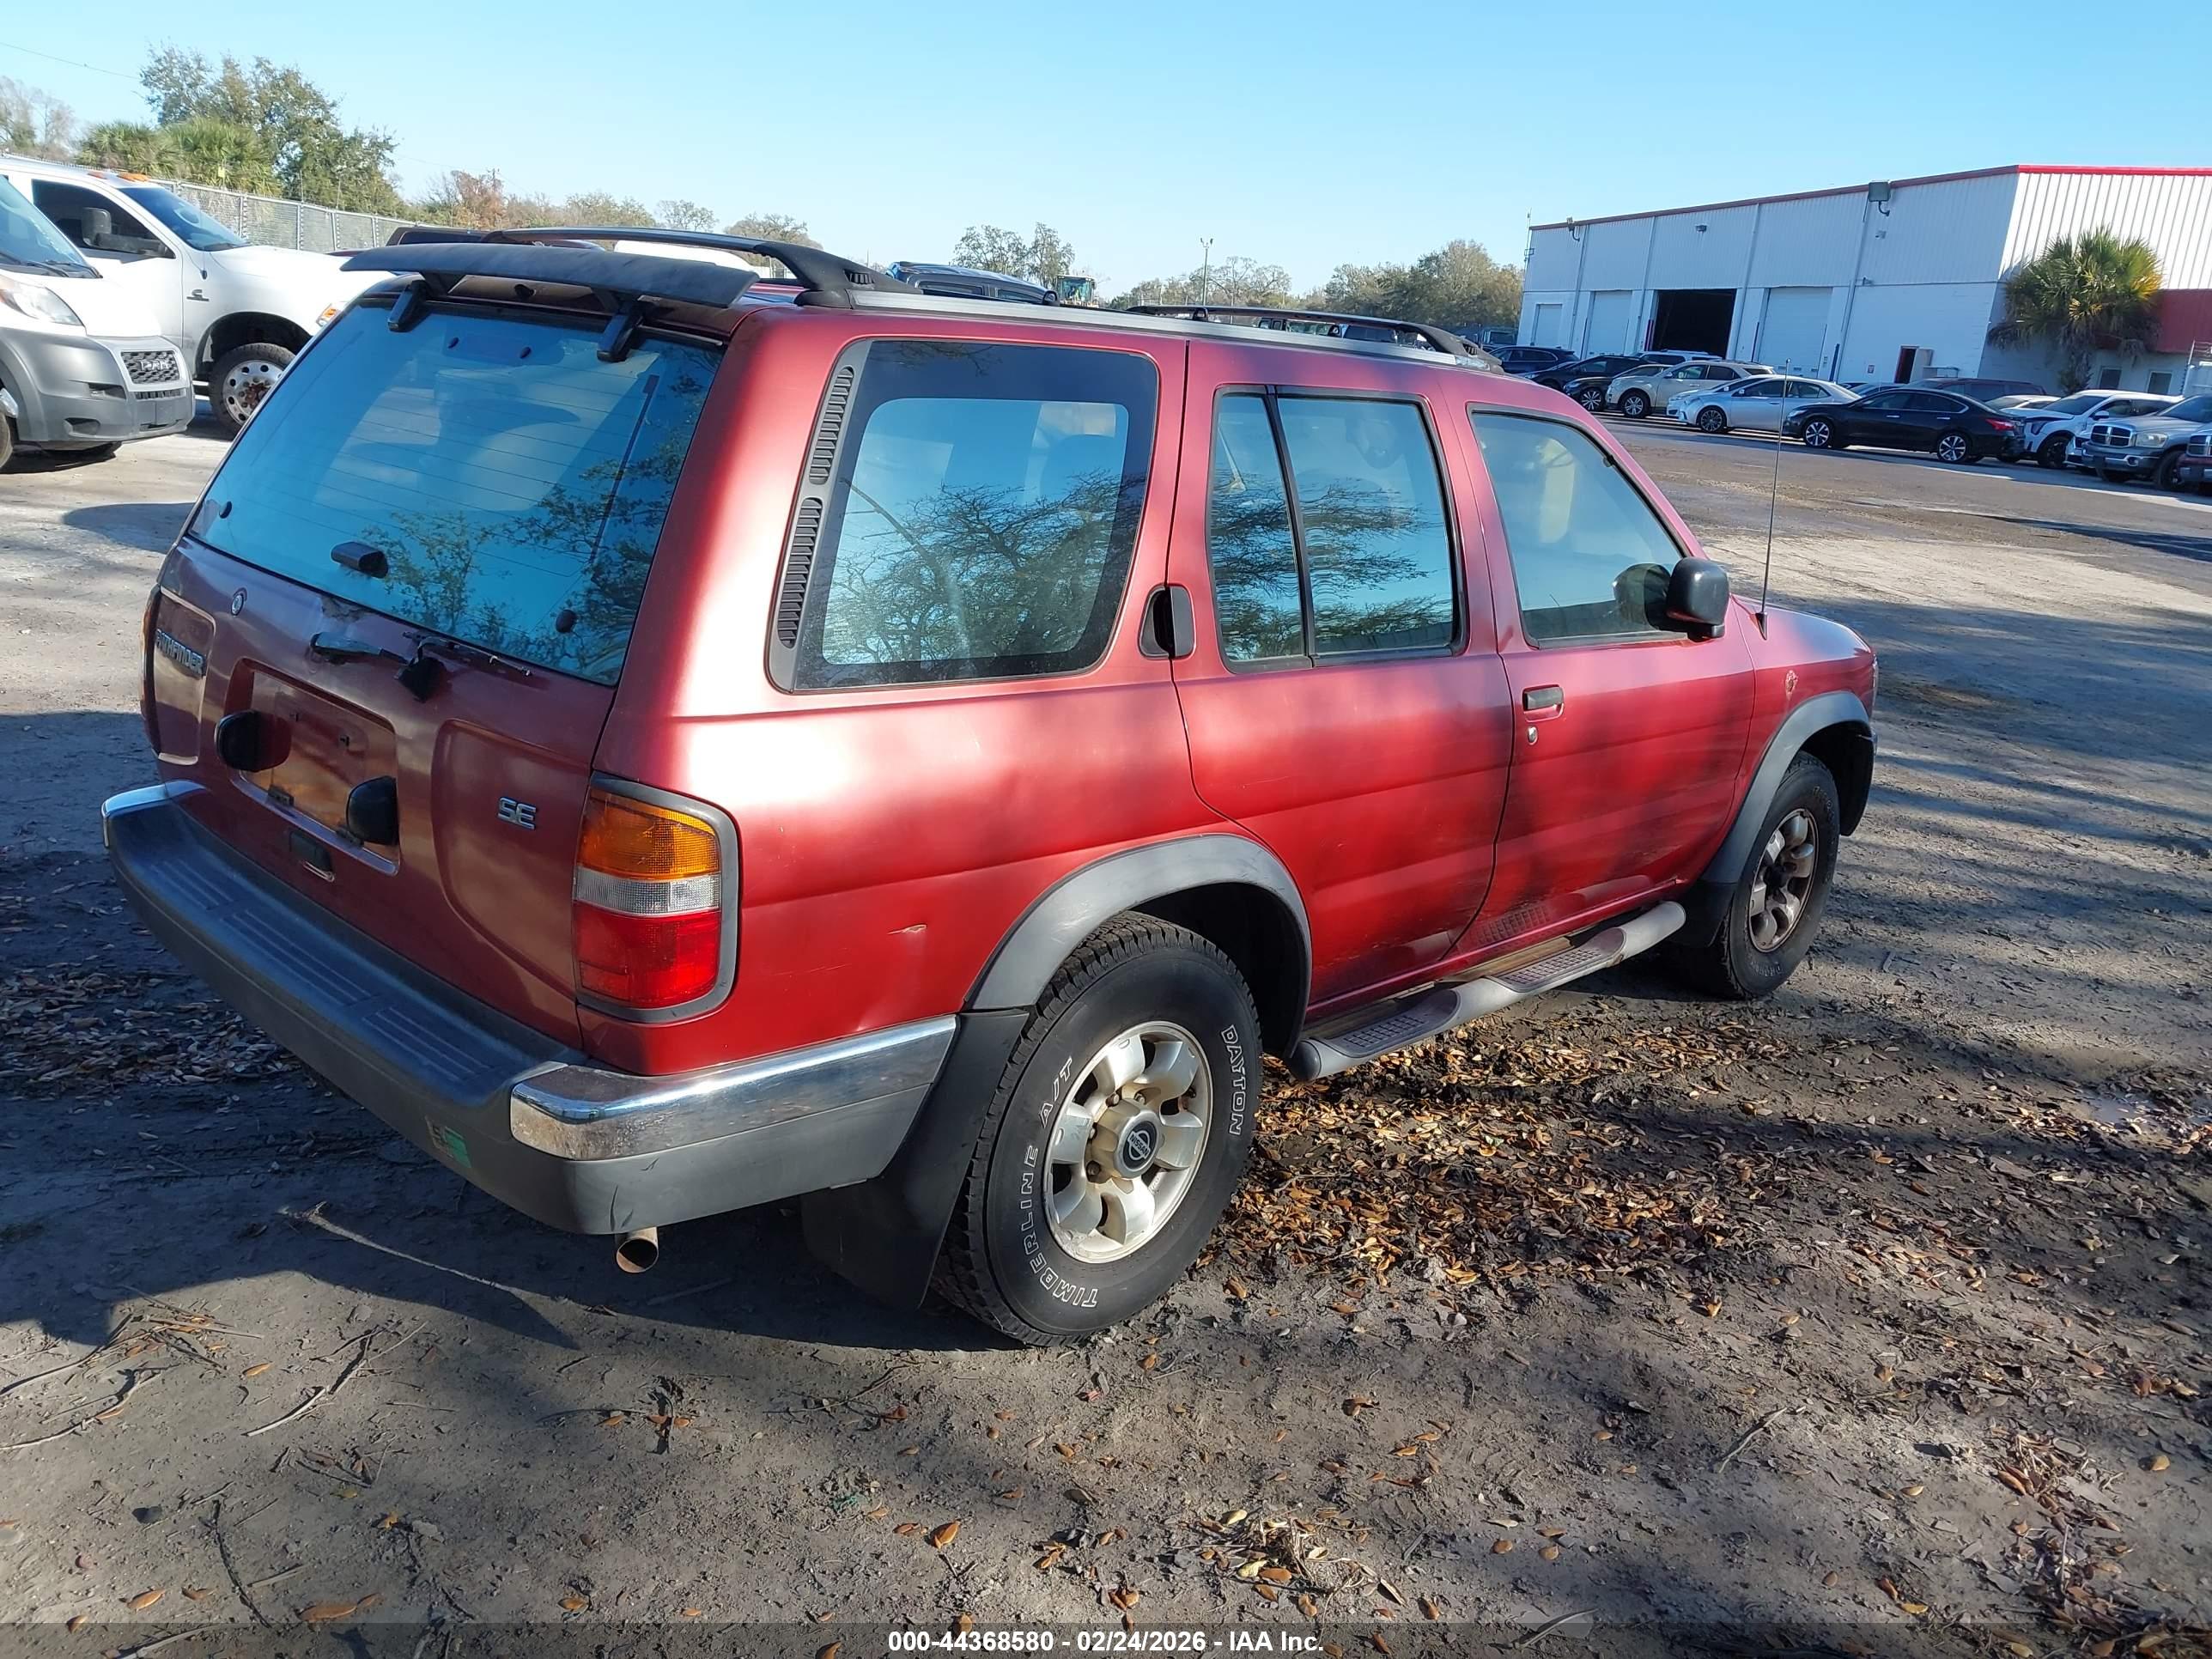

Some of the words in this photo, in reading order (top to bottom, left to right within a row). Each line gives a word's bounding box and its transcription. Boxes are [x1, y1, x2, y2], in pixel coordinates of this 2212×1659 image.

[497, 797, 537, 830] SE
[1221, 1024, 1246, 1136] DAYTON
[1129, 1133, 1150, 1156] NISSAN
[1020, 1145, 1098, 1308] TIMBERLINE
